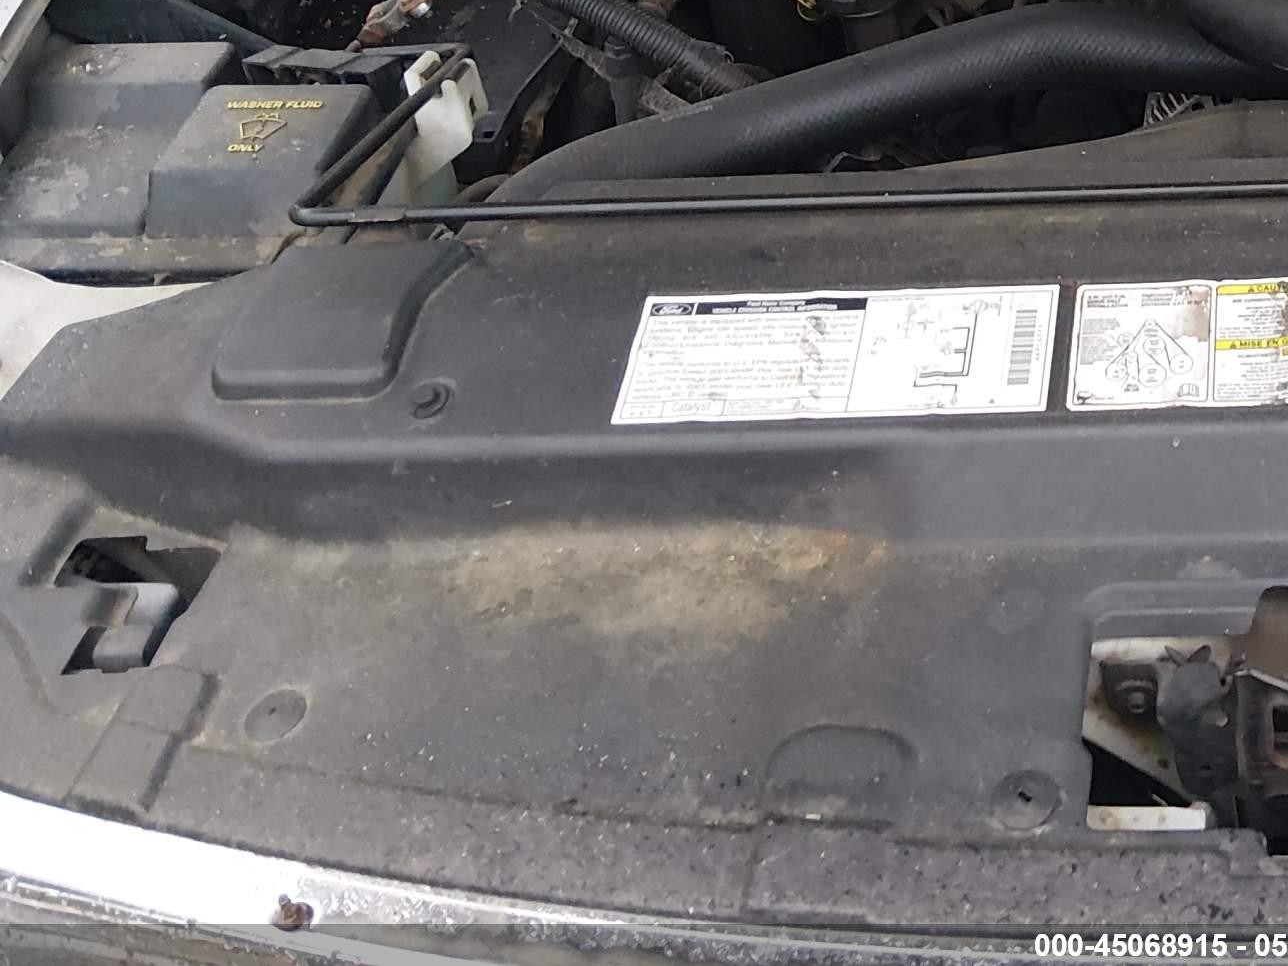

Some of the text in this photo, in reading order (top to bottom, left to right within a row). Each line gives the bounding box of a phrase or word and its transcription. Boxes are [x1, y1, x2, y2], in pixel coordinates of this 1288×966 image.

[227, 99, 323, 110] WASHER FLUID
[227, 143, 264, 153] ONLY
[1239, 339, 1263, 348] MISE
[1266, 338, 1279, 347] EN
[671, 401, 711, 414] Catalyst
